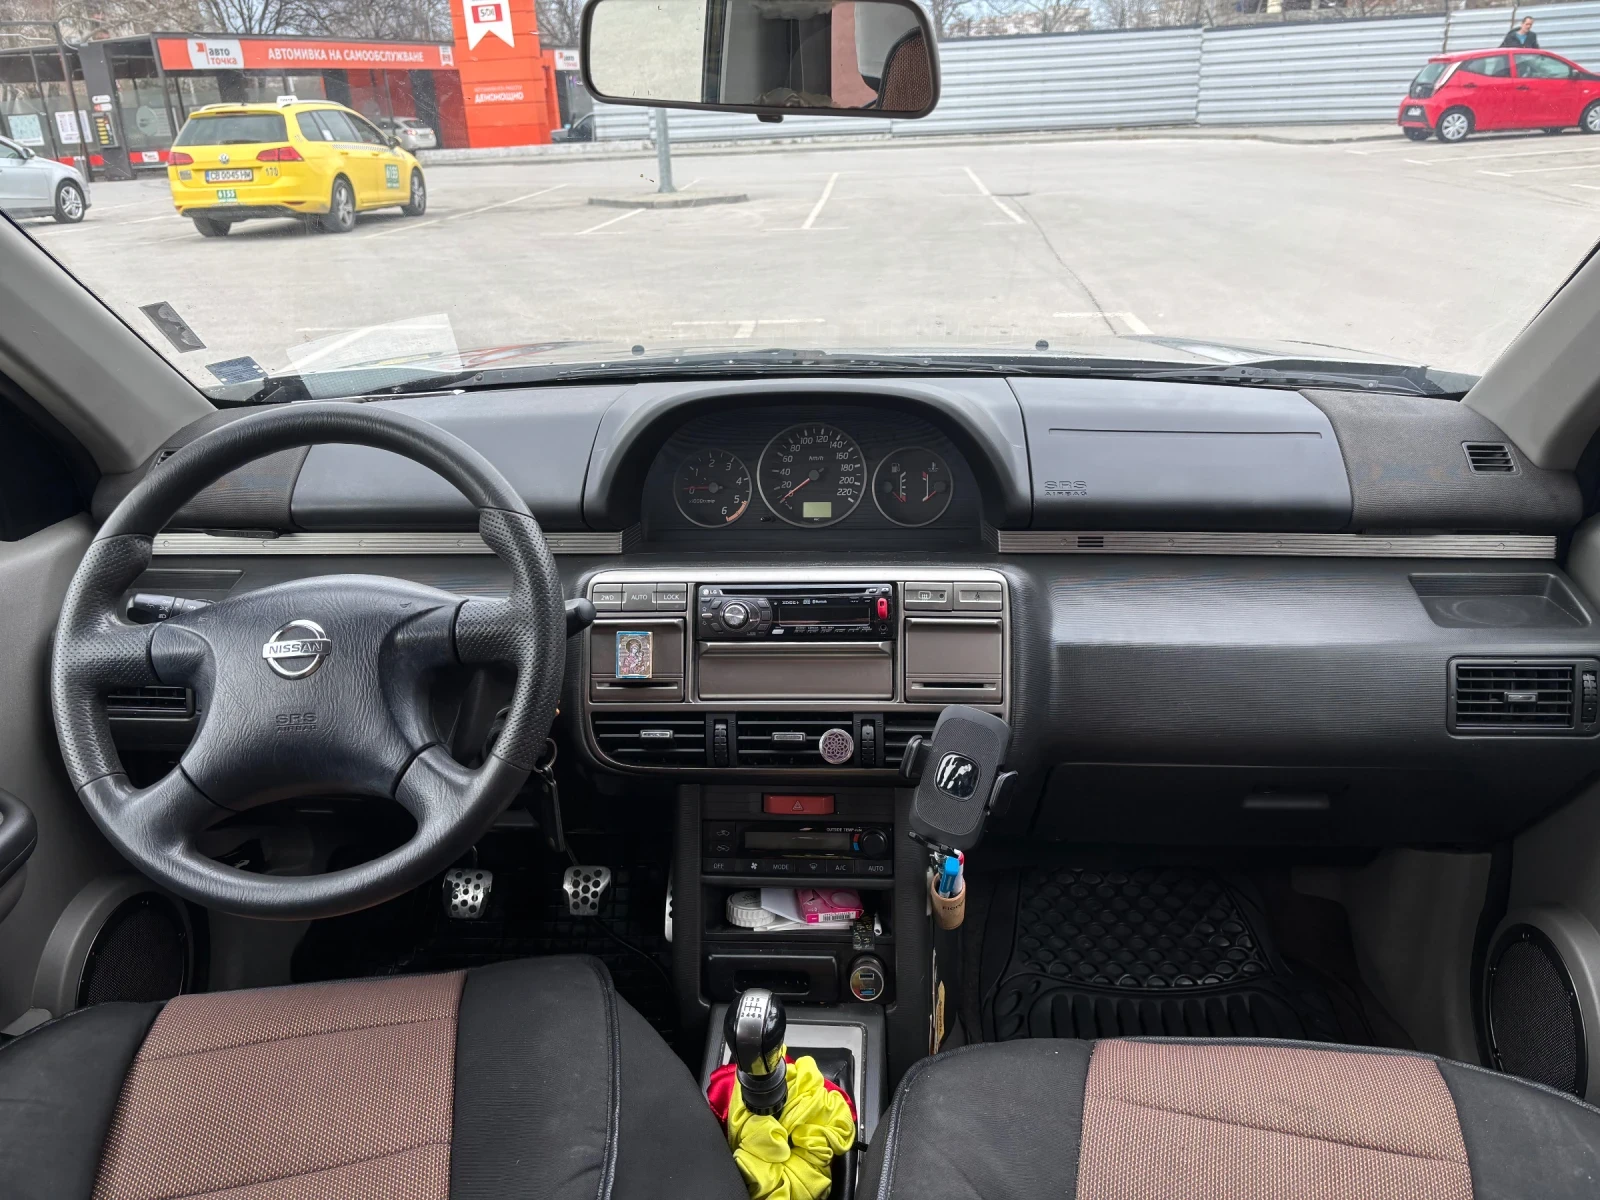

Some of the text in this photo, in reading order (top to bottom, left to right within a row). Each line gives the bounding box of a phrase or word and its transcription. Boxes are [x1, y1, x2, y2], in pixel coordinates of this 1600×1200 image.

[208, 47, 230, 57] авто
[268, 47, 424, 62] АВТОМИВКА НА САМООБСЛУЖВАНЕ
[210, 57, 238, 65] точка
[790, 444, 800, 452] 80
[708, 459, 715, 468] 2
[725, 462, 732, 471] 3
[780, 468, 791, 476] 40
[736, 477, 742, 485] 4
[1044, 480, 1087, 489] SRS
[837, 488, 852, 496] 220
[733, 495, 740, 503] 5
[721, 506, 728, 515] 6
[268, 642, 323, 655] NISSAN
[275, 712, 318, 725] SRS
